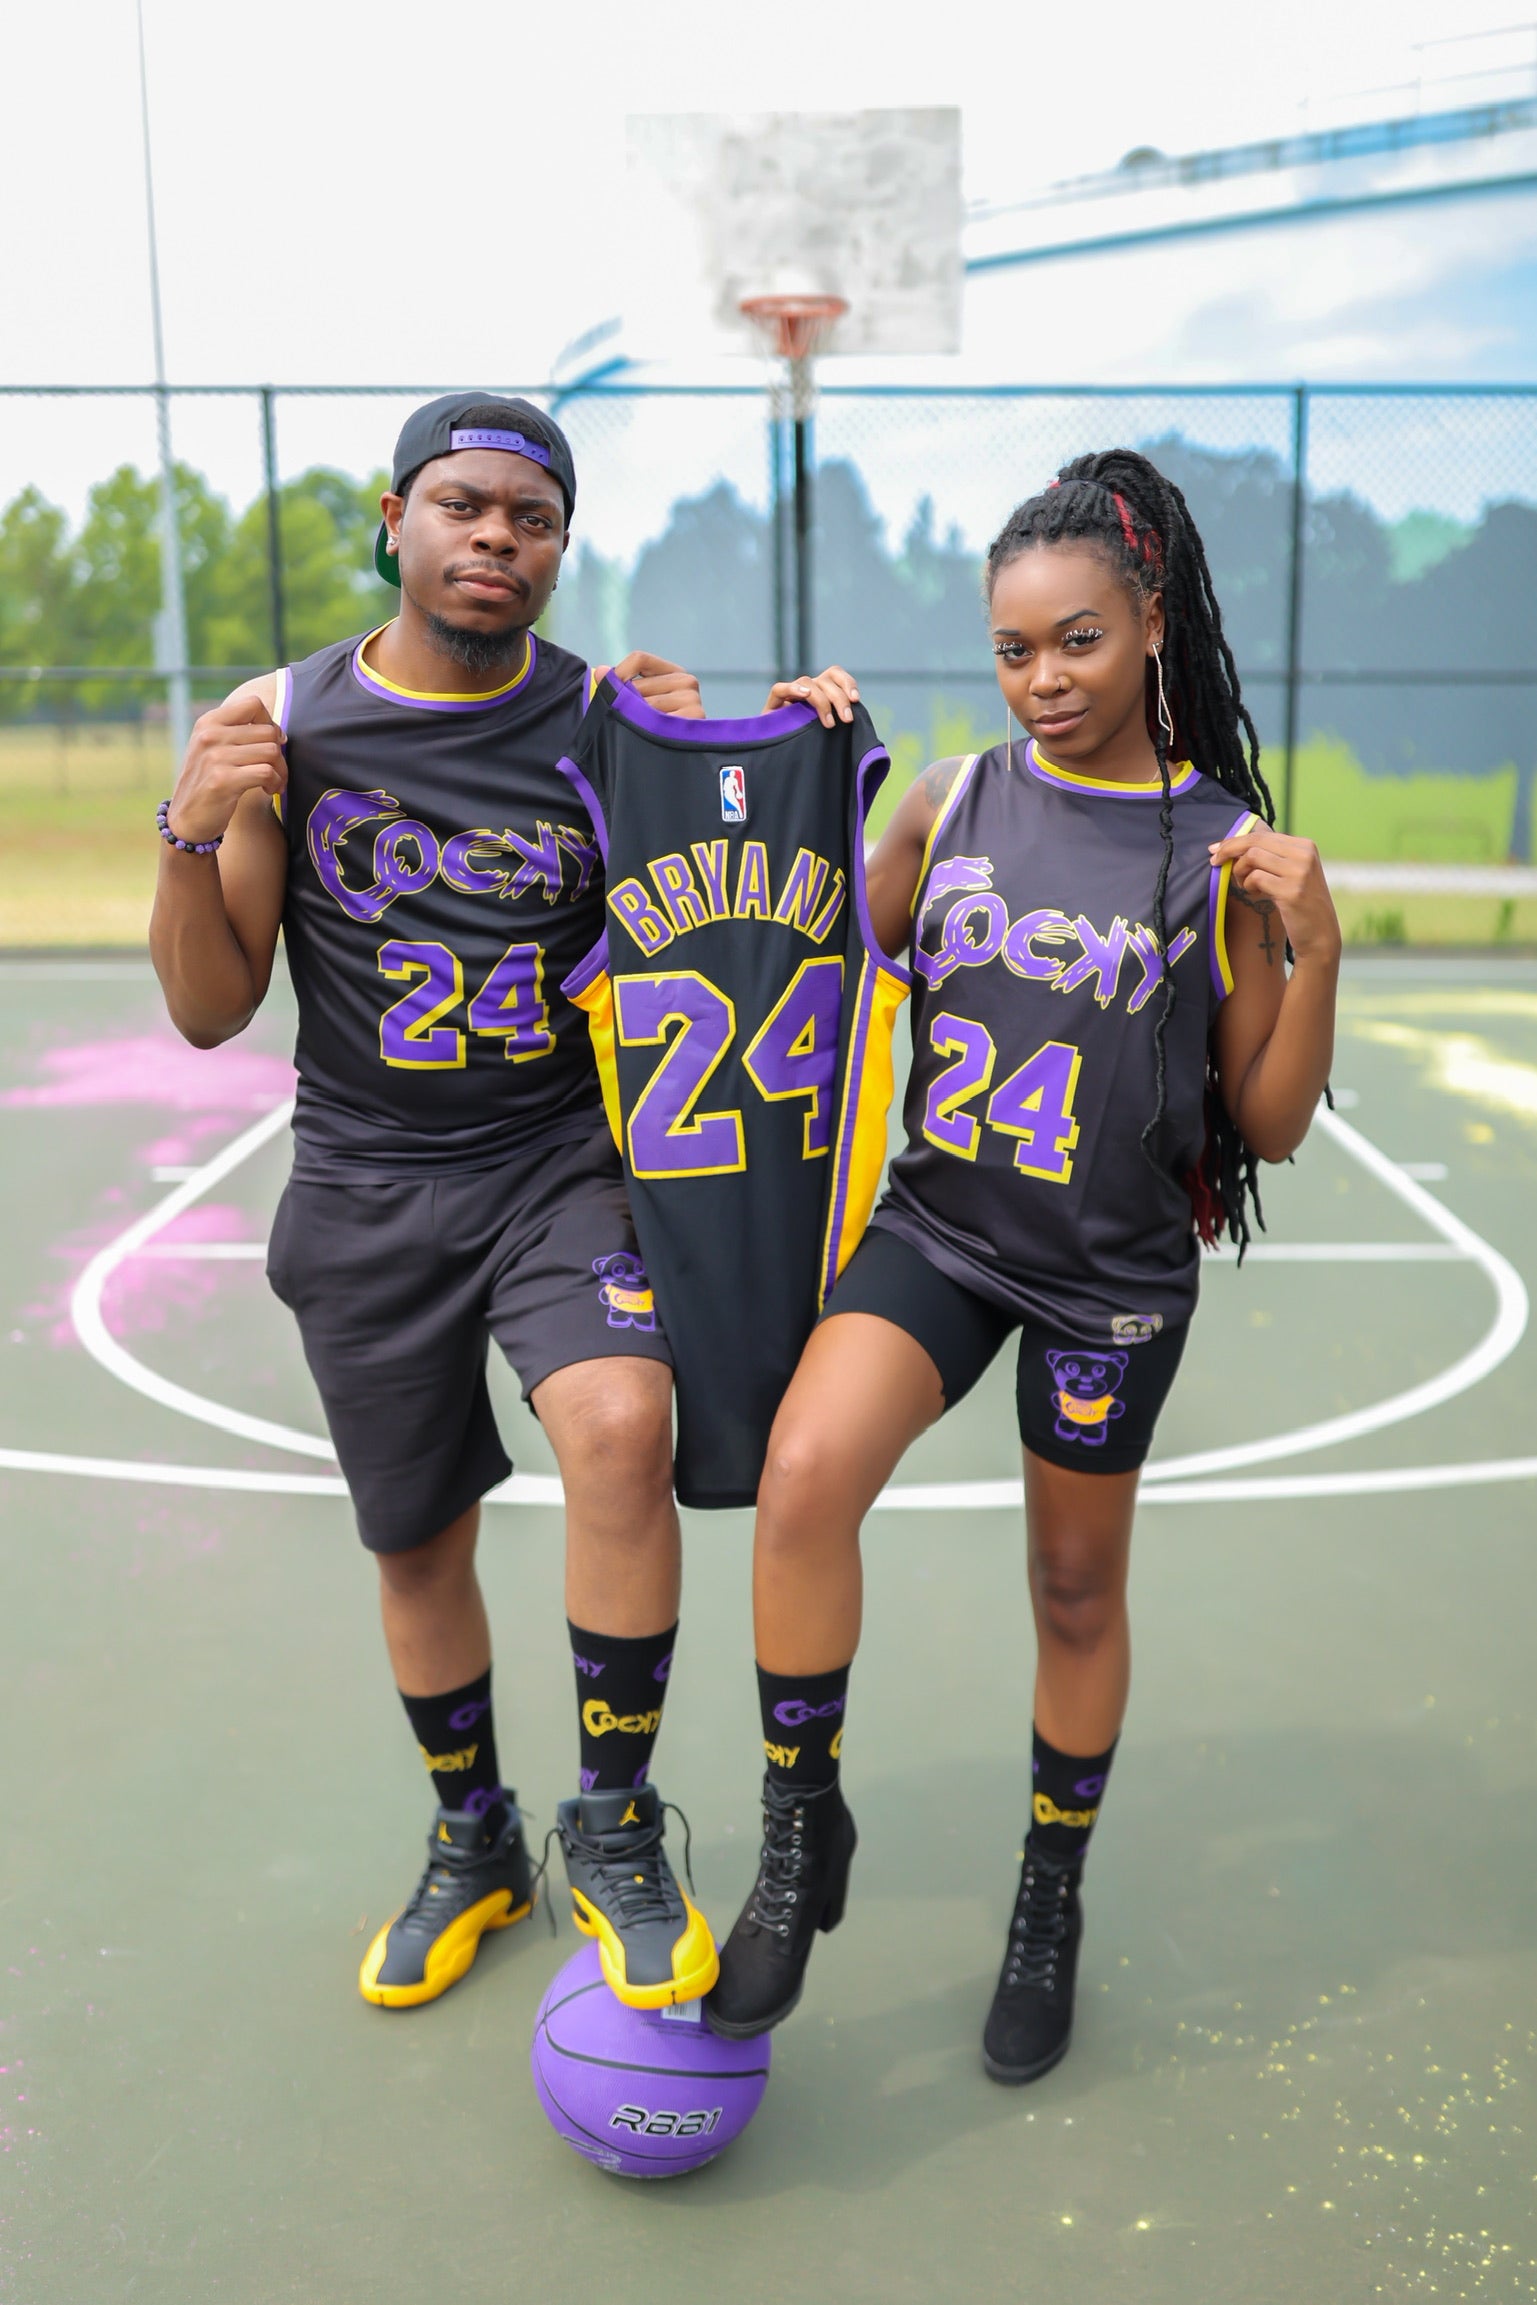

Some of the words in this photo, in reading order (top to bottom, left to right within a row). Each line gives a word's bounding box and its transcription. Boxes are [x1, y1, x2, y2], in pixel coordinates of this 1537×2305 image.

[606, 838, 847, 959] BRYANT
[376, 938, 556, 1070] 24
[613, 955, 846, 1178] 24
[922, 1011, 1082, 1184] 24
